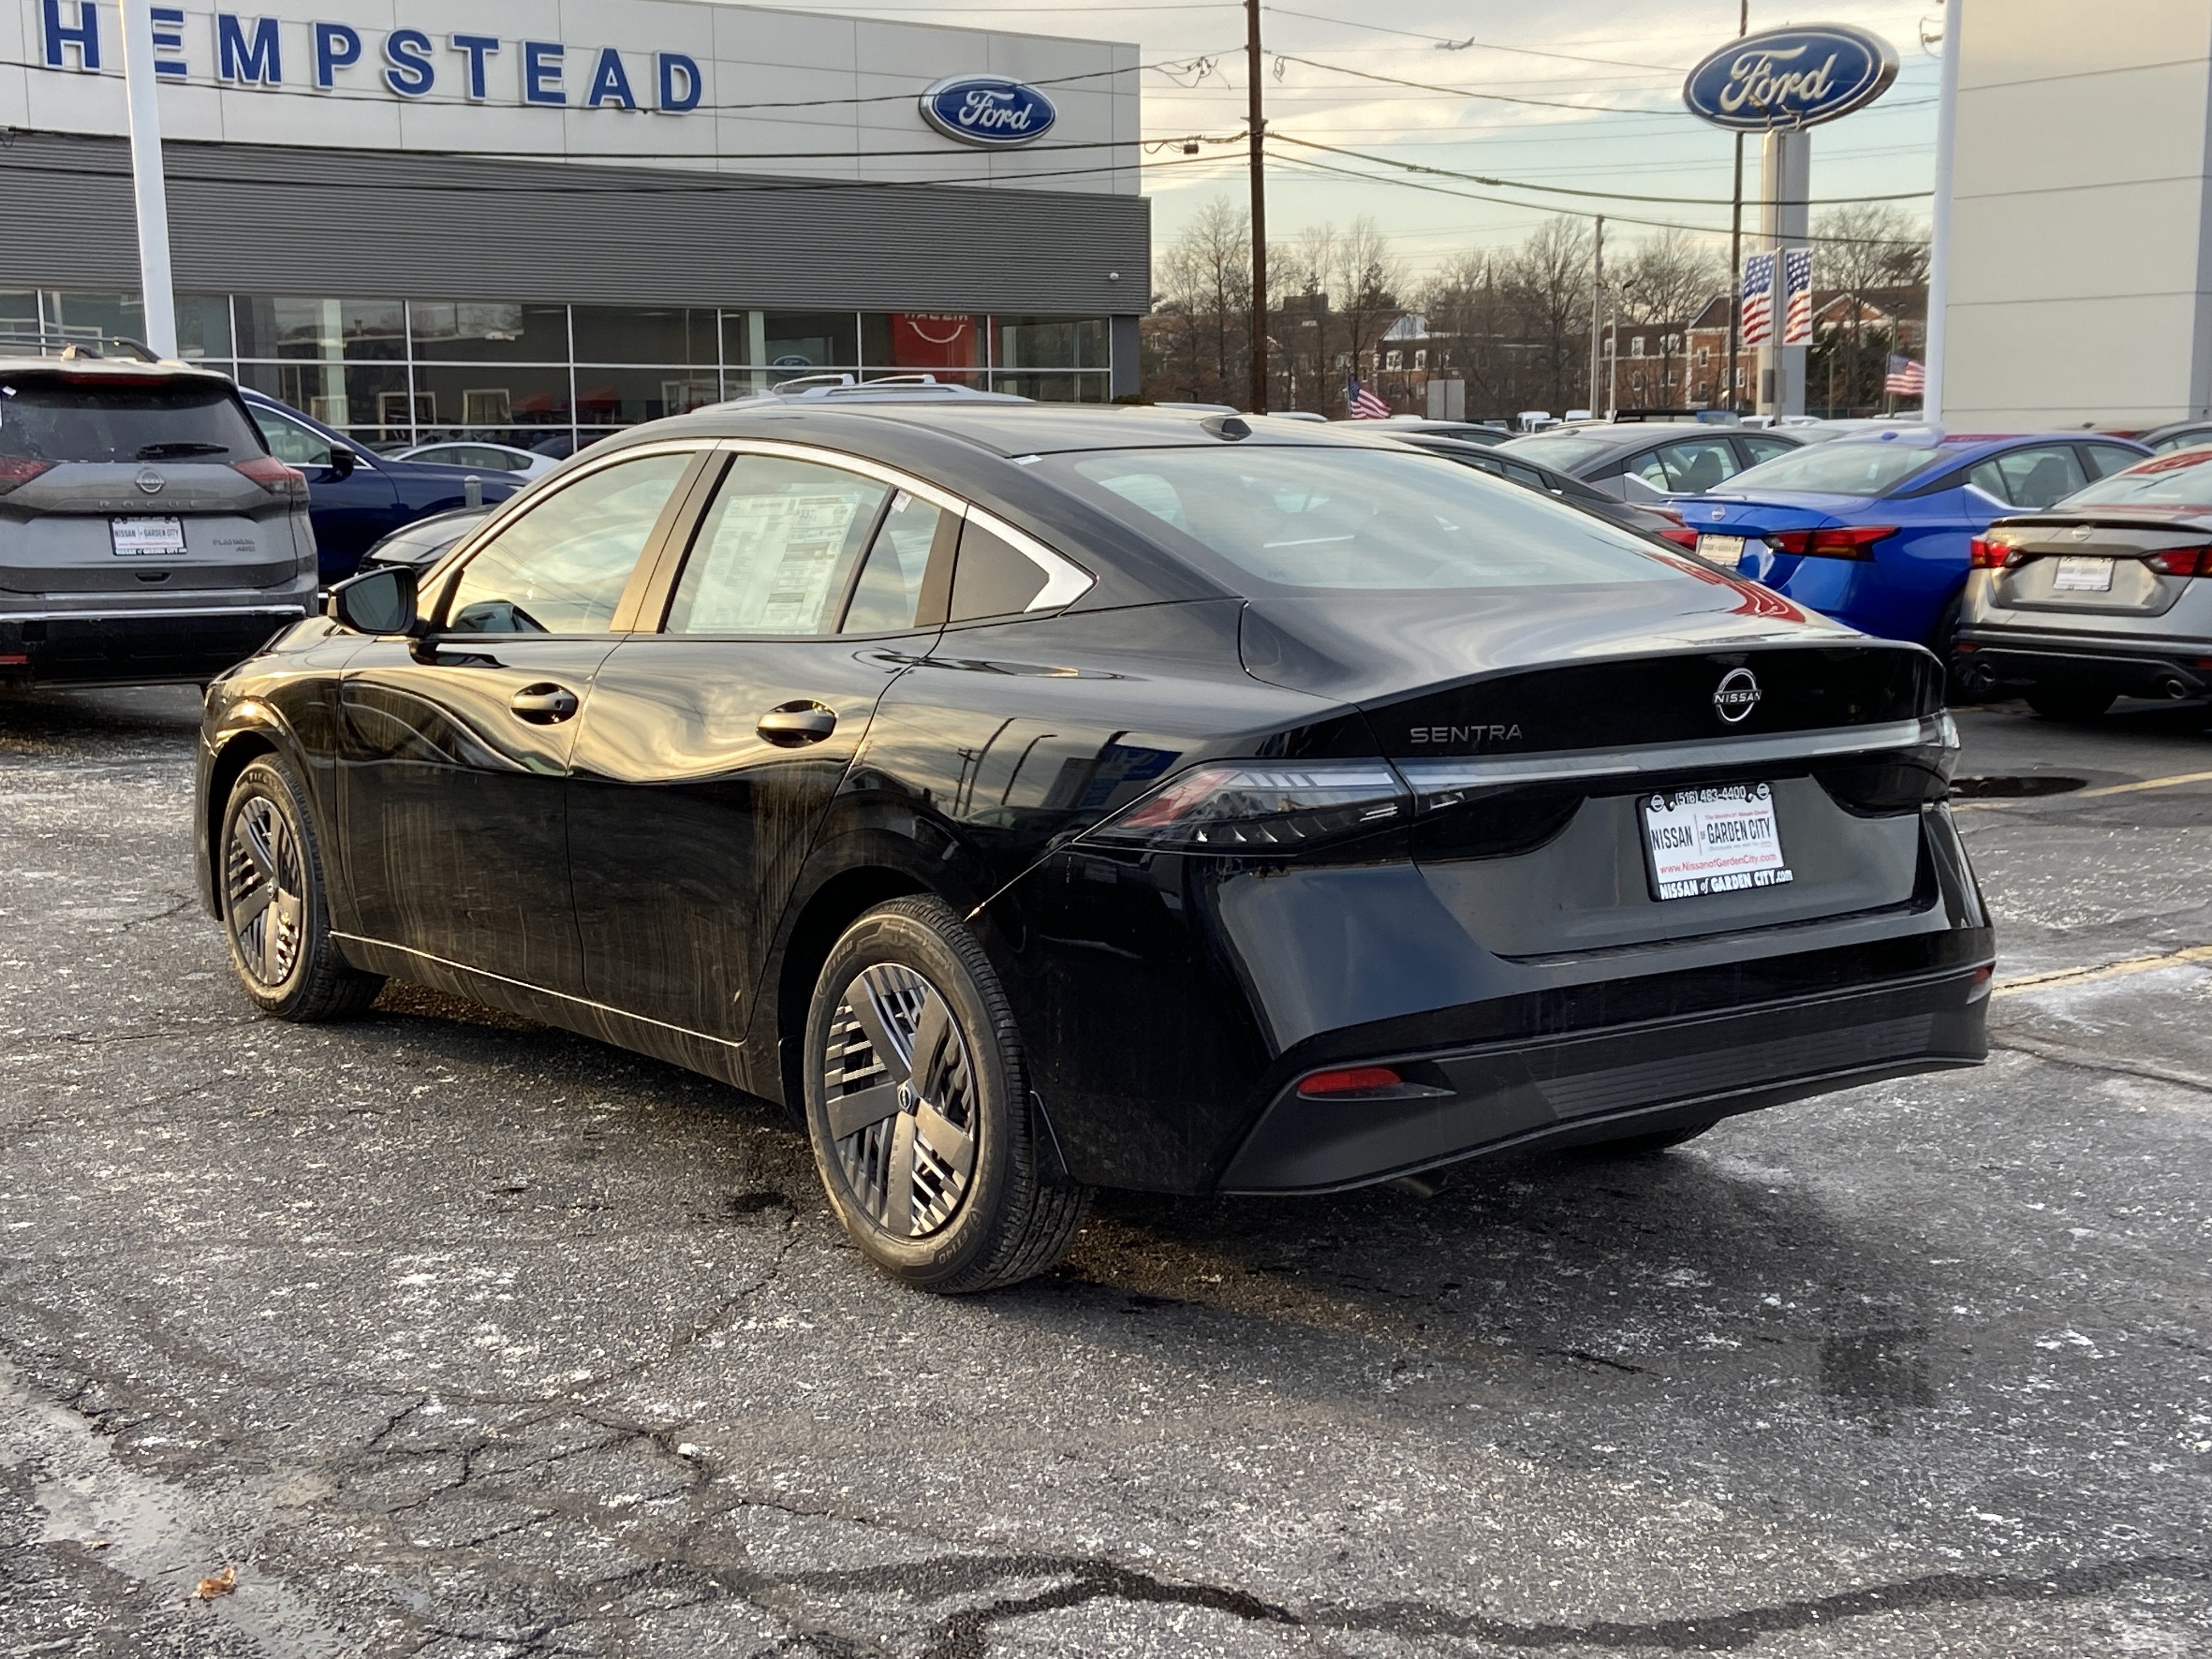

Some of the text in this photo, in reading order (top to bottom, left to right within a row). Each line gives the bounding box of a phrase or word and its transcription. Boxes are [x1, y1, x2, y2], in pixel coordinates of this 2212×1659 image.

[38, 0, 702, 114] HEMPSTEAD
[1720, 44, 1839, 112] Ford
[958, 89, 1033, 130] Ford
[1714, 692, 1761, 703] NISSAN
[1410, 724, 1523, 744] SENTRA
[1674, 786, 1747, 806] (516) 483-4400
[1651, 826, 1693, 851] NISSAN
[1707, 820, 1748, 844] GARDEN
[1748, 817, 1771, 839] CITY
[1659, 879, 1699, 900] NISSAN
[1700, 878, 1709, 894] of
[1710, 872, 1753, 893] GARDEN
